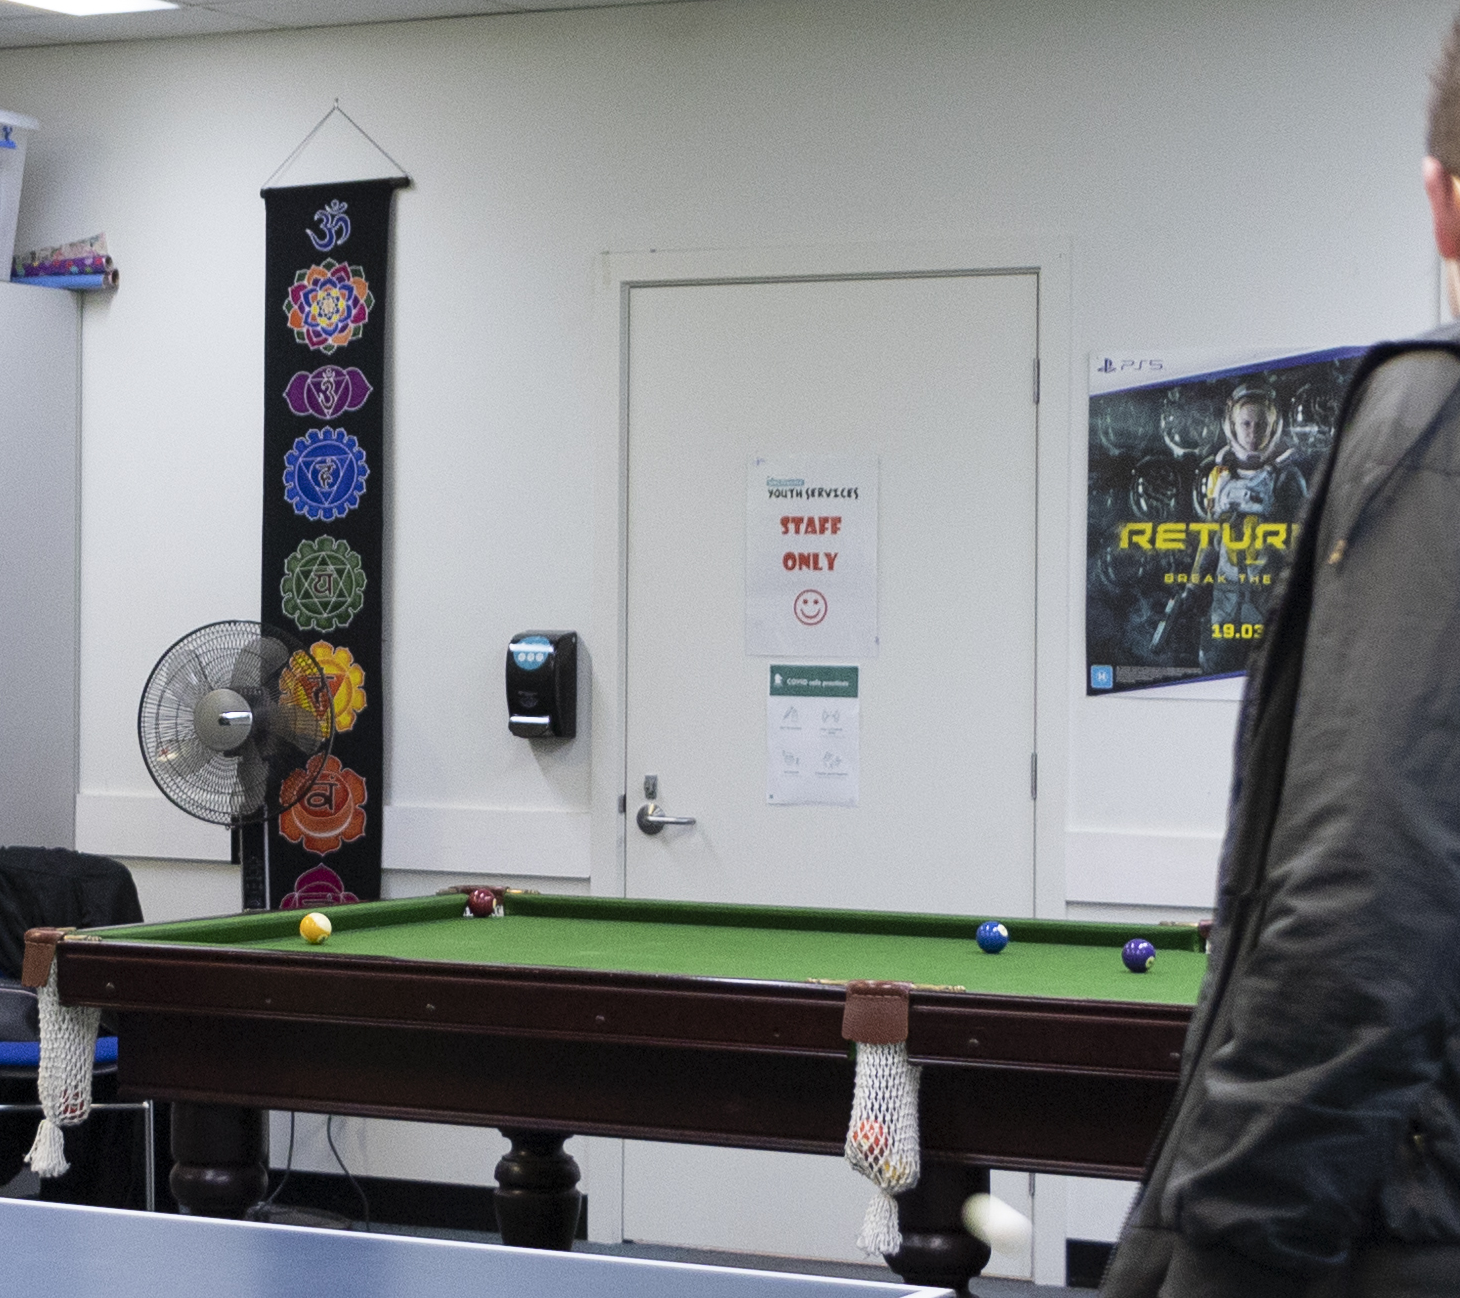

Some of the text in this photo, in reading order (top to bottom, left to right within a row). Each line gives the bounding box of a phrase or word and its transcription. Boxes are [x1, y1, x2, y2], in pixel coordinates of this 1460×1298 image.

[1120, 358, 1163, 370] PS5
[768, 487, 859, 500] YOUTH SERVICES
[780, 516, 842, 535] STAFF
[1119, 522, 1299, 551] RETUR
[782, 551, 839, 571] ONLY
[1164, 572, 1272, 584] BREAK THE
[786, 678, 808, 686] COVID
